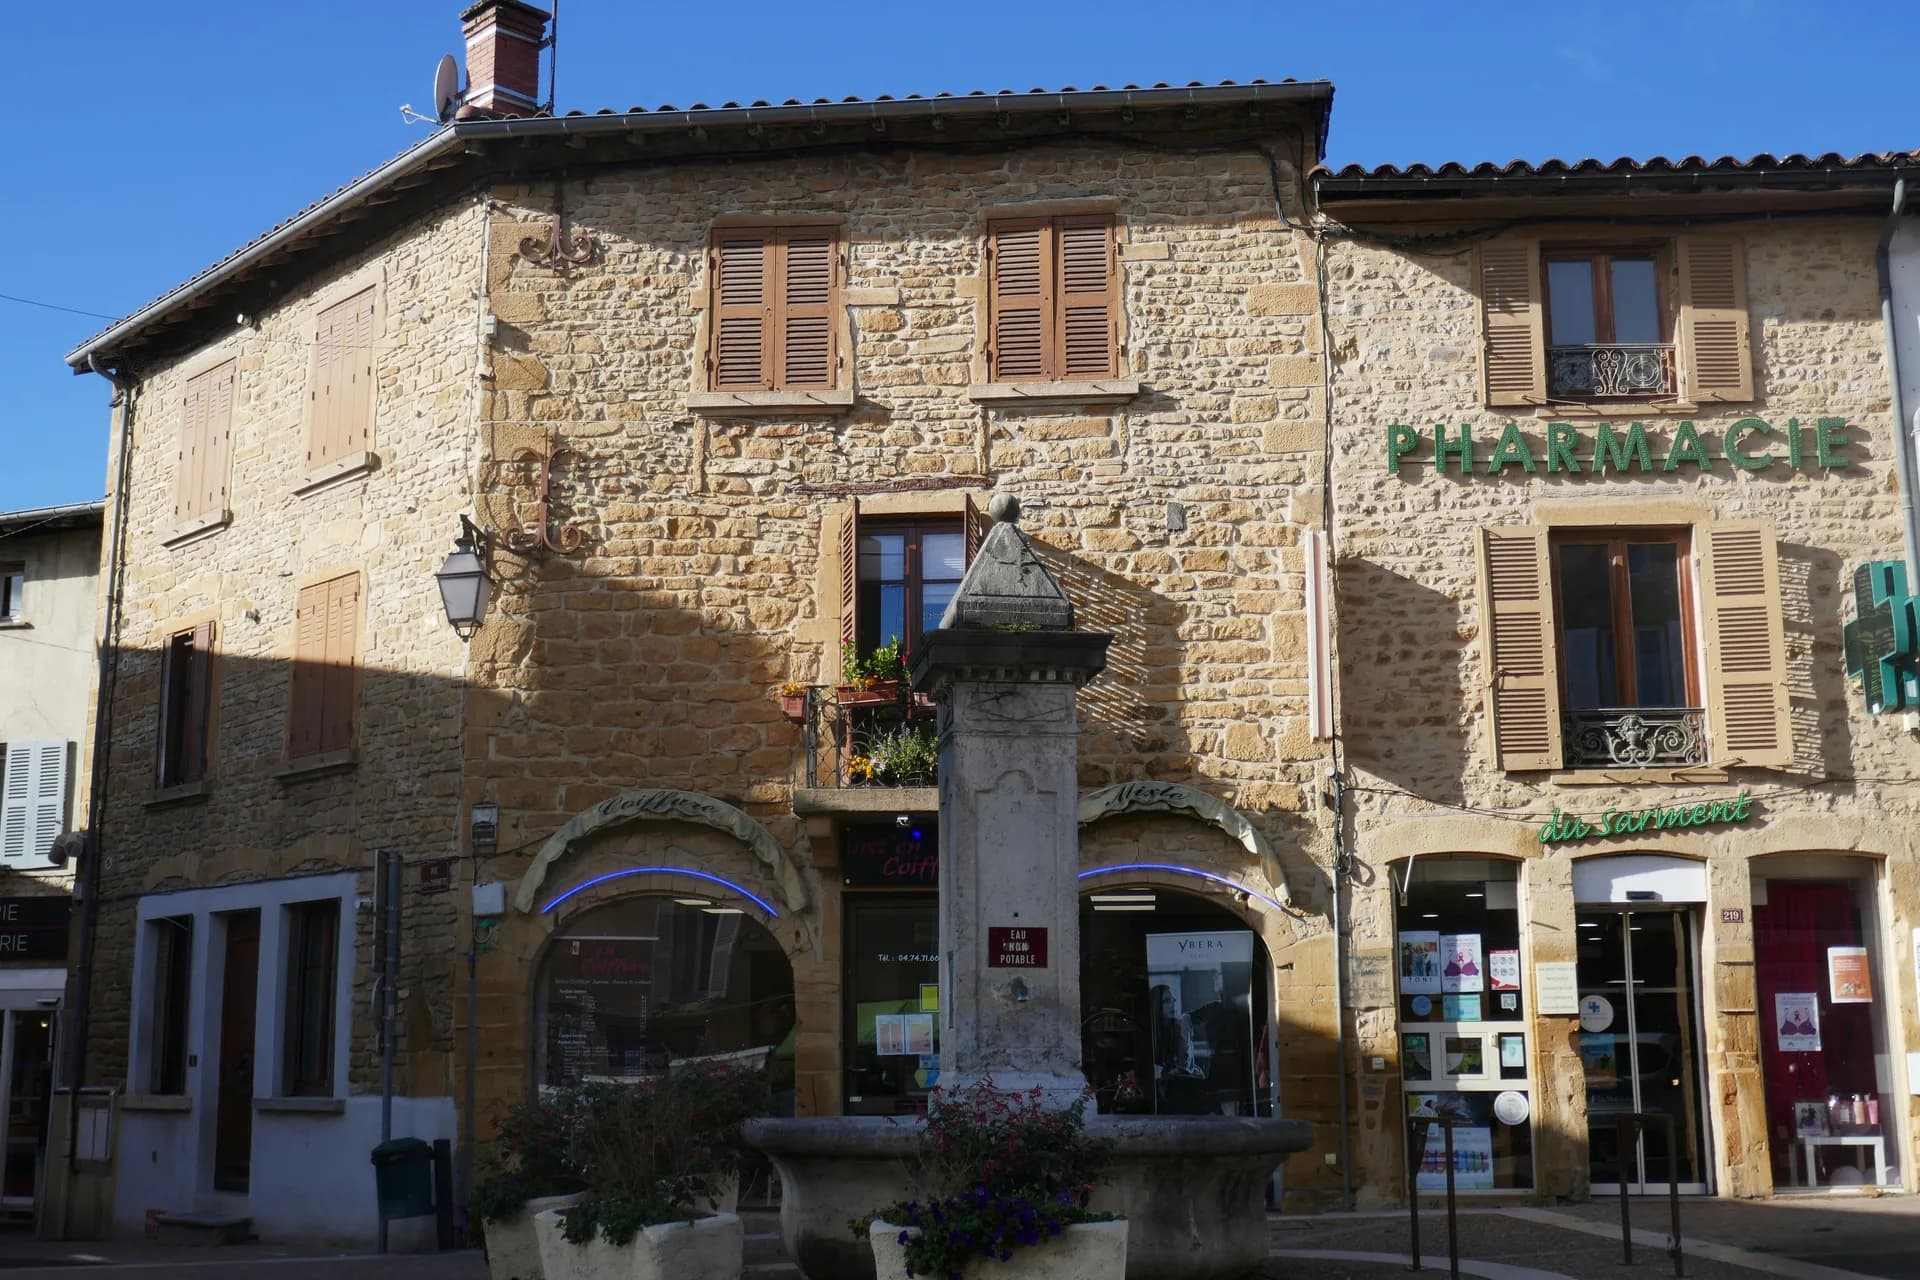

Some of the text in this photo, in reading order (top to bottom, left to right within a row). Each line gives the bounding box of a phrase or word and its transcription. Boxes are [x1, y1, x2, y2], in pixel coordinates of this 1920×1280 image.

[1388, 417, 1850, 473] PHARMACIE
[598, 790, 716, 815] Coiffure
[1538, 793, 1752, 844] du Sarment
[0, 903, 20, 921] IE
[1723, 911, 1739, 921] 219
[1010, 929, 1026, 940] EAU
[1008, 942, 1029, 952] NON
[1000, 954, 1036, 964] POTABLE
